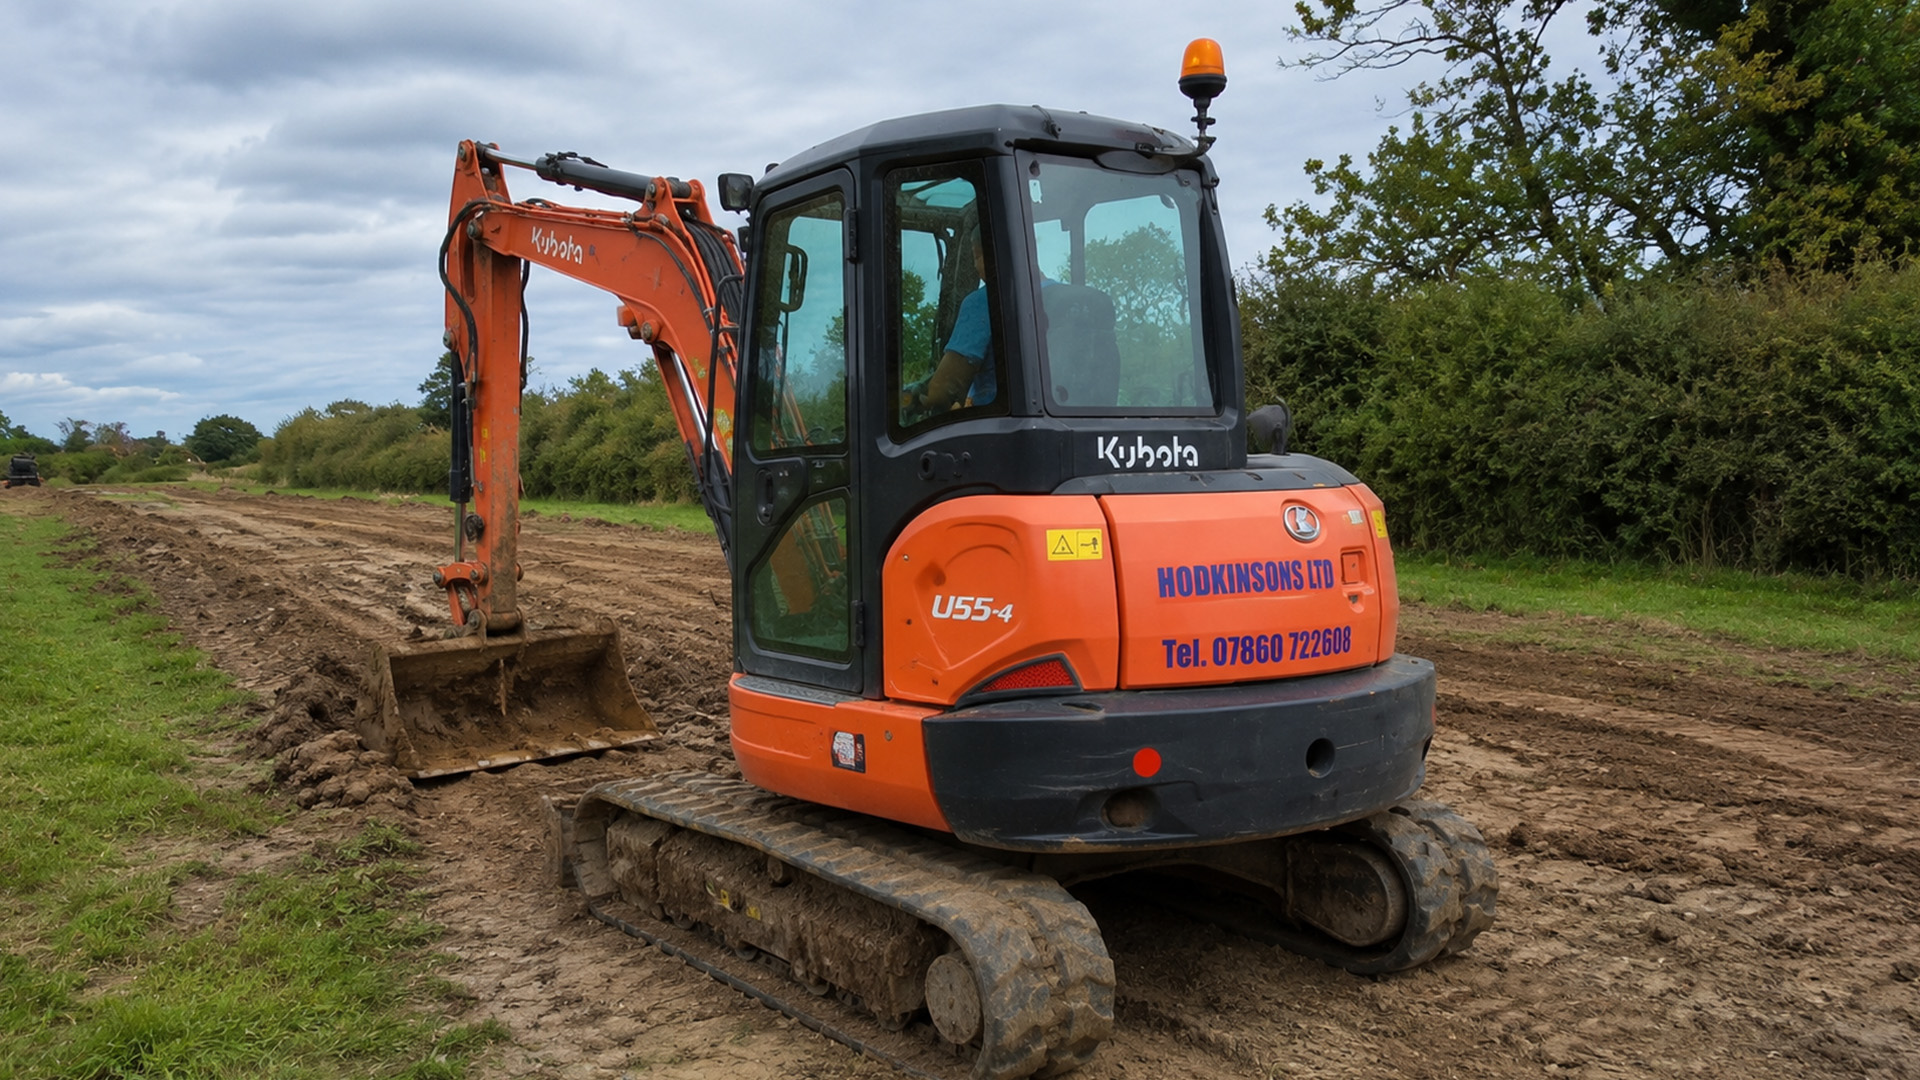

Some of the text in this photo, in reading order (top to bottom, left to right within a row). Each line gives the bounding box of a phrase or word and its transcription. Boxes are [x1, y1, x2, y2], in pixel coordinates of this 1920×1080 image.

[531, 226, 582, 264] Kubota
[1097, 436, 1198, 468] Kubota
[1157, 559, 1335, 598] HODKINSONS LTD
[932, 595, 1013, 623] U55-4
[1162, 626, 1352, 669] Tel. 07860 722608
